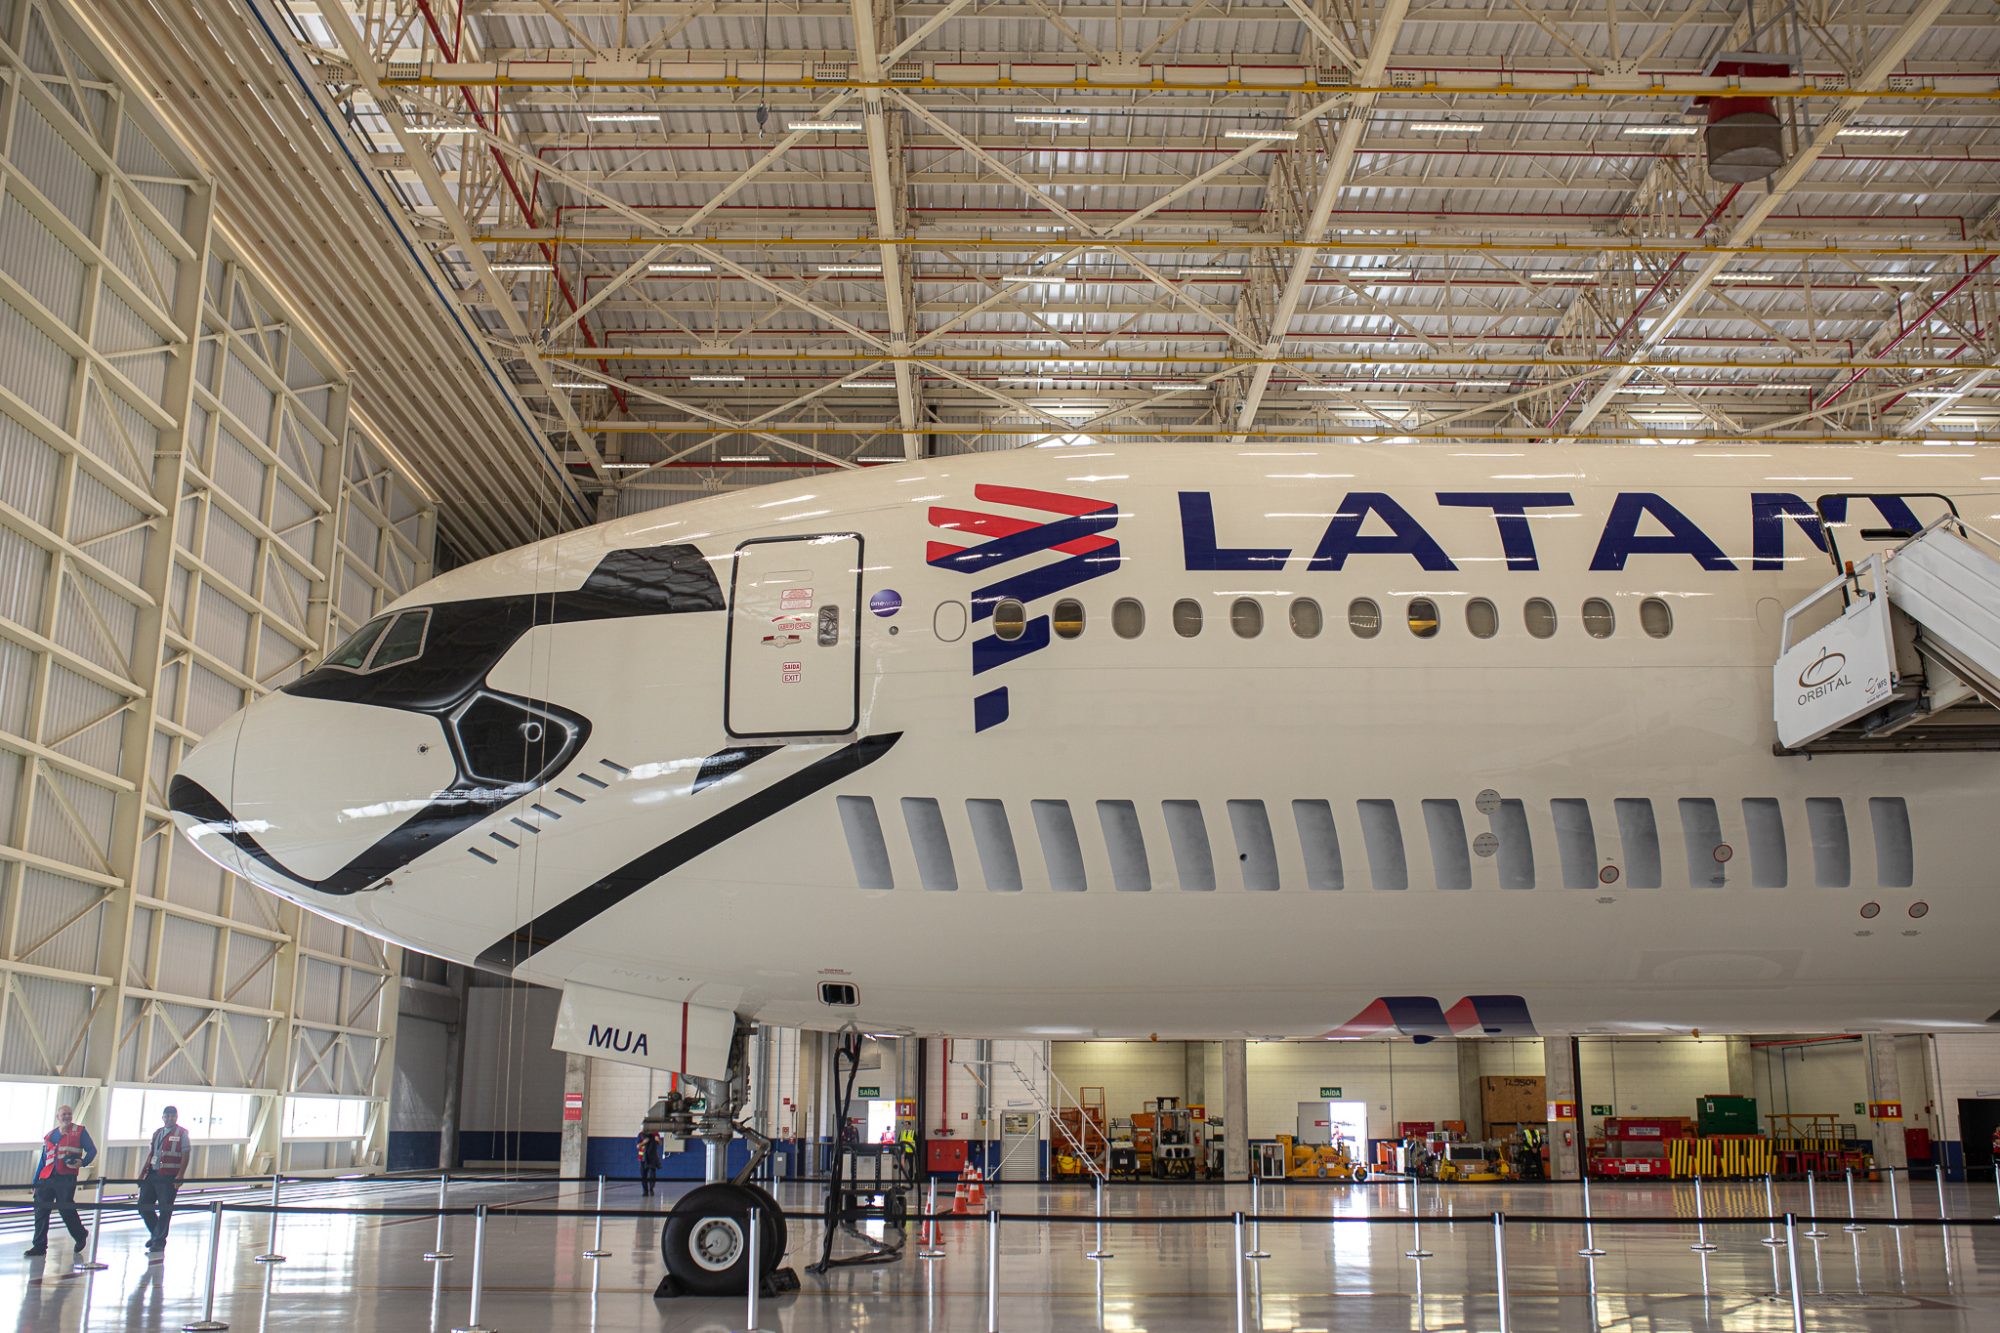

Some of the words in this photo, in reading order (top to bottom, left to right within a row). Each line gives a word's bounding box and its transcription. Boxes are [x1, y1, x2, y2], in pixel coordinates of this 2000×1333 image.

[1797, 675, 1852, 706] ORBITAL
[588, 1024, 648, 1056] MUA
[1321, 1088, 1341, 1097] SAÍDA
[1193, 1109, 1200, 1118] E
[1562, 1106, 1571, 1116] E
[1887, 1106, 1897, 1116] H
